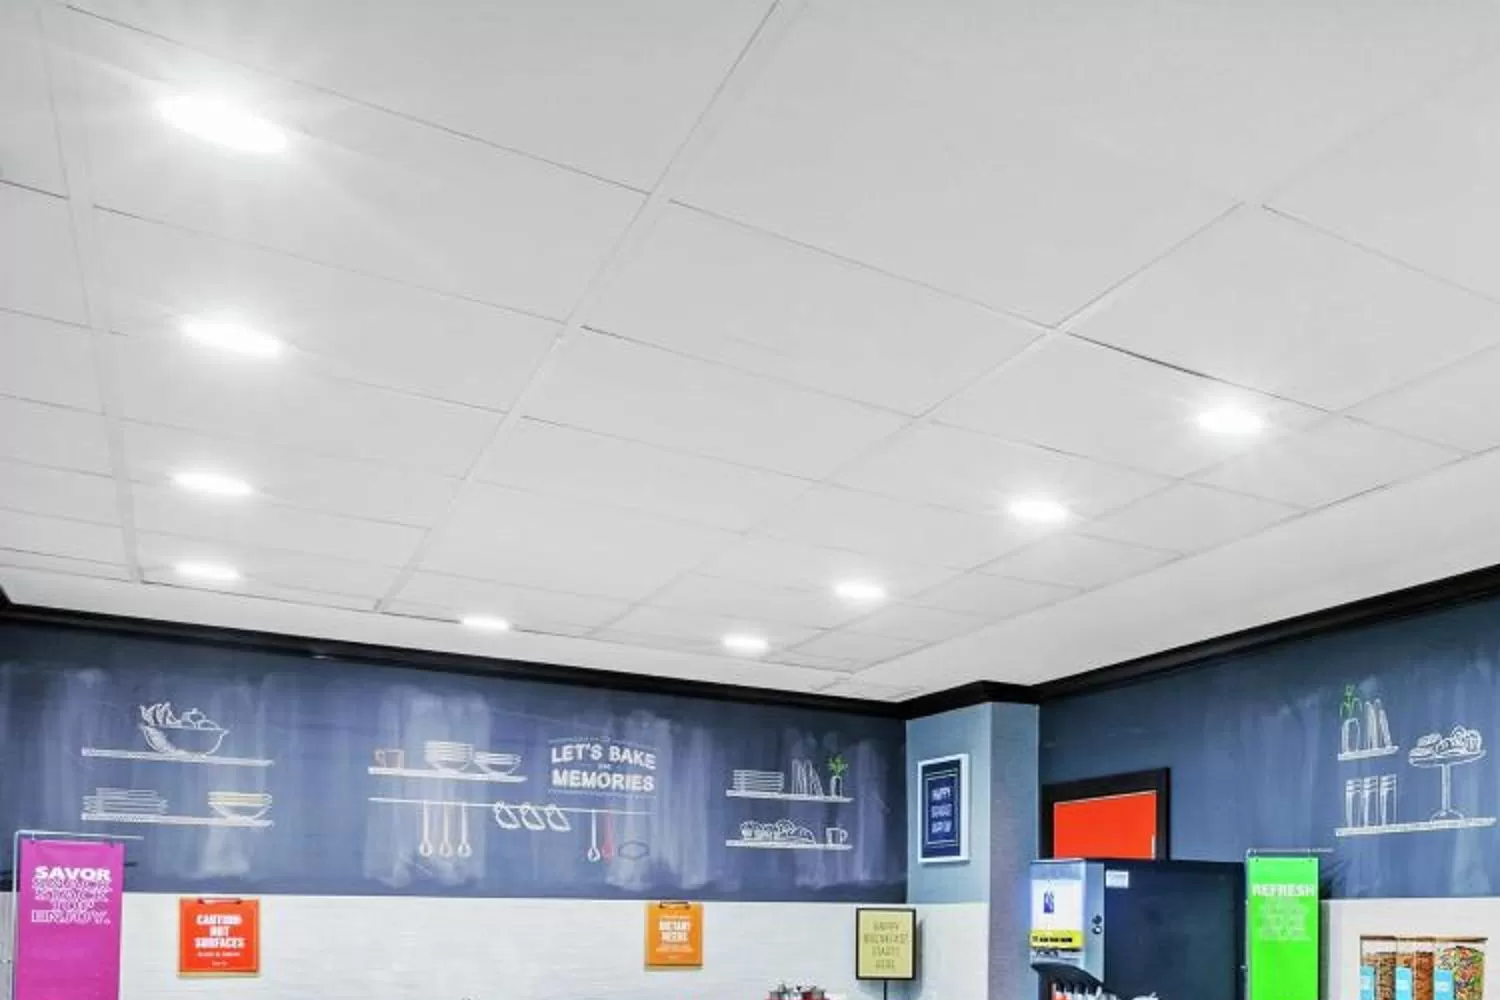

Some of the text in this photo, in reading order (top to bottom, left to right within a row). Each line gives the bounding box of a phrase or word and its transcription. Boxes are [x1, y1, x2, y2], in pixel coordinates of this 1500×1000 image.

[551, 743, 657, 770] LET'S BAKE
[552, 768, 655, 792] MEMORIES
[34, 866, 111, 881] SAVOR
[1252, 884, 1315, 897] REFRESH
[209, 926, 230, 937] HOT
[194, 937, 246, 949] SURFACES
